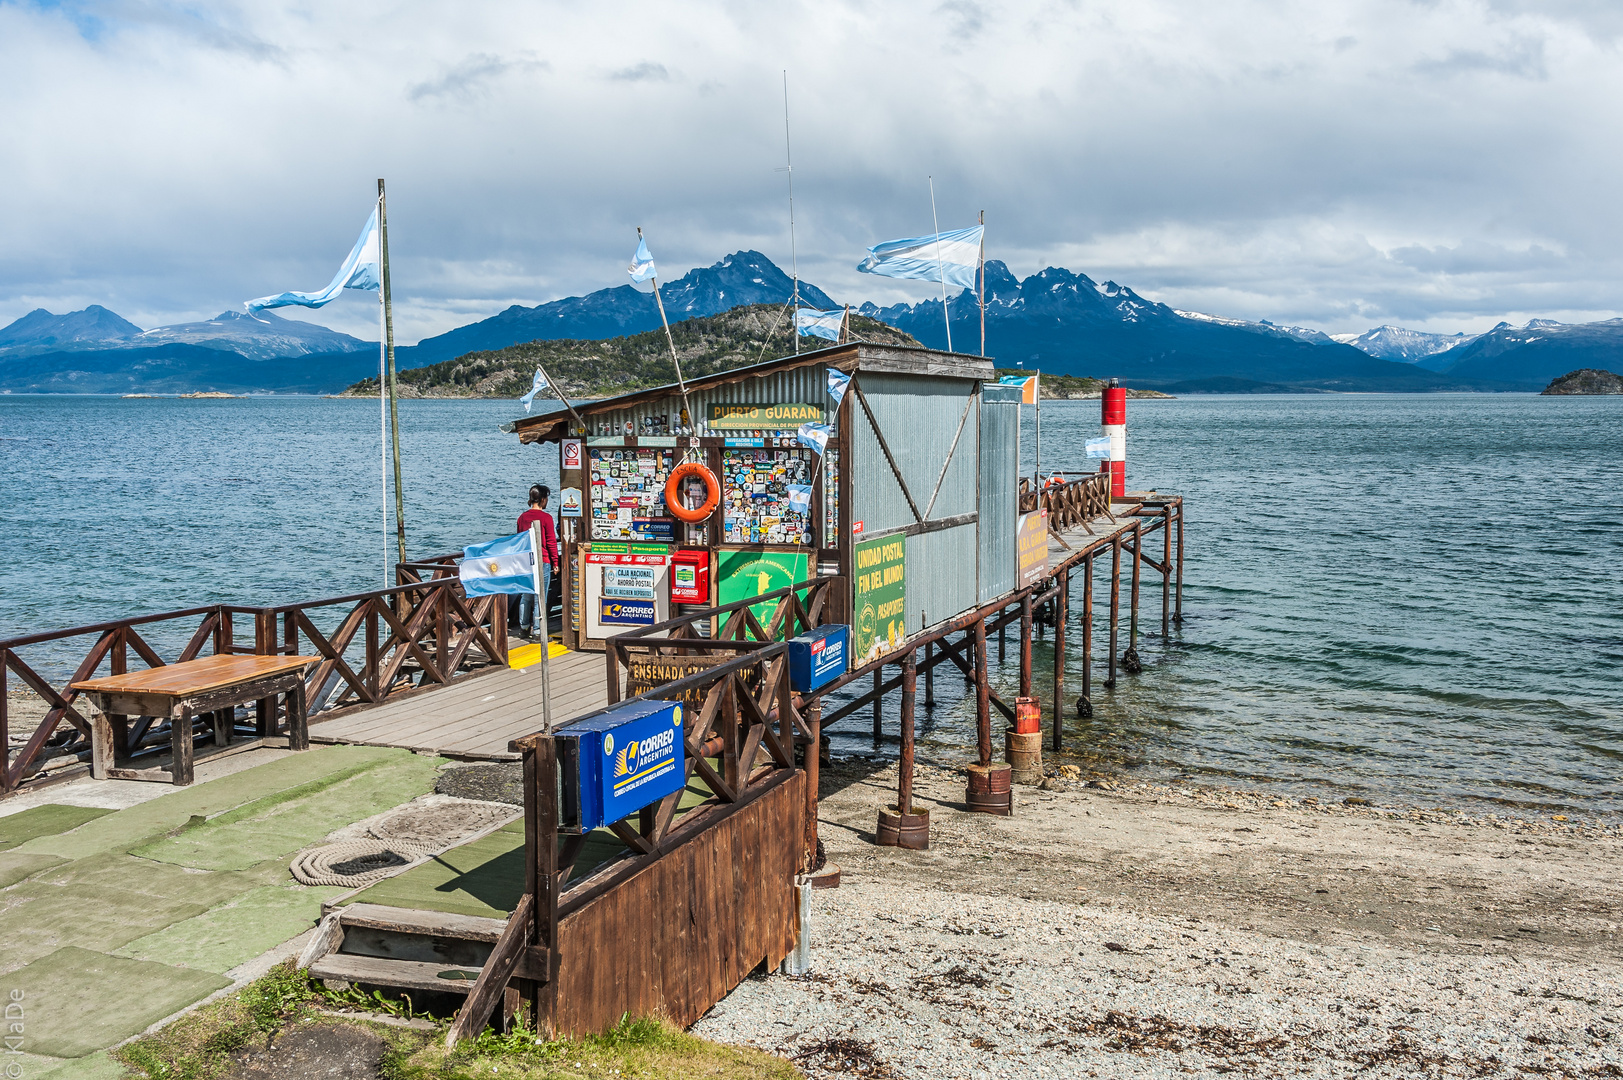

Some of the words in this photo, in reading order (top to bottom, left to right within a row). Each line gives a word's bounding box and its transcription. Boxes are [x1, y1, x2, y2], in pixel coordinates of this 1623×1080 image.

[714, 406, 759, 418] PUERTO
[1027, 514, 1041, 532] PUERTO
[858, 547, 882, 569] UNIDAD
[882, 541, 903, 563] POSTAL
[732, 560, 754, 578] EXTREMO
[765, 560, 794, 580] AMERICANO
[859, 574, 870, 594] FIN
[871, 570, 883, 590] DEL
[884, 564, 904, 586] MUNDO
[622, 606, 654, 615] CORREO
[877, 597, 904, 620] PASAPORTES
[826, 641, 842, 655] CORREO
[634, 665, 685, 680] ENSENADA
[640, 729, 674, 756] CORREO
[640, 745, 673, 767] ARGENTINO
